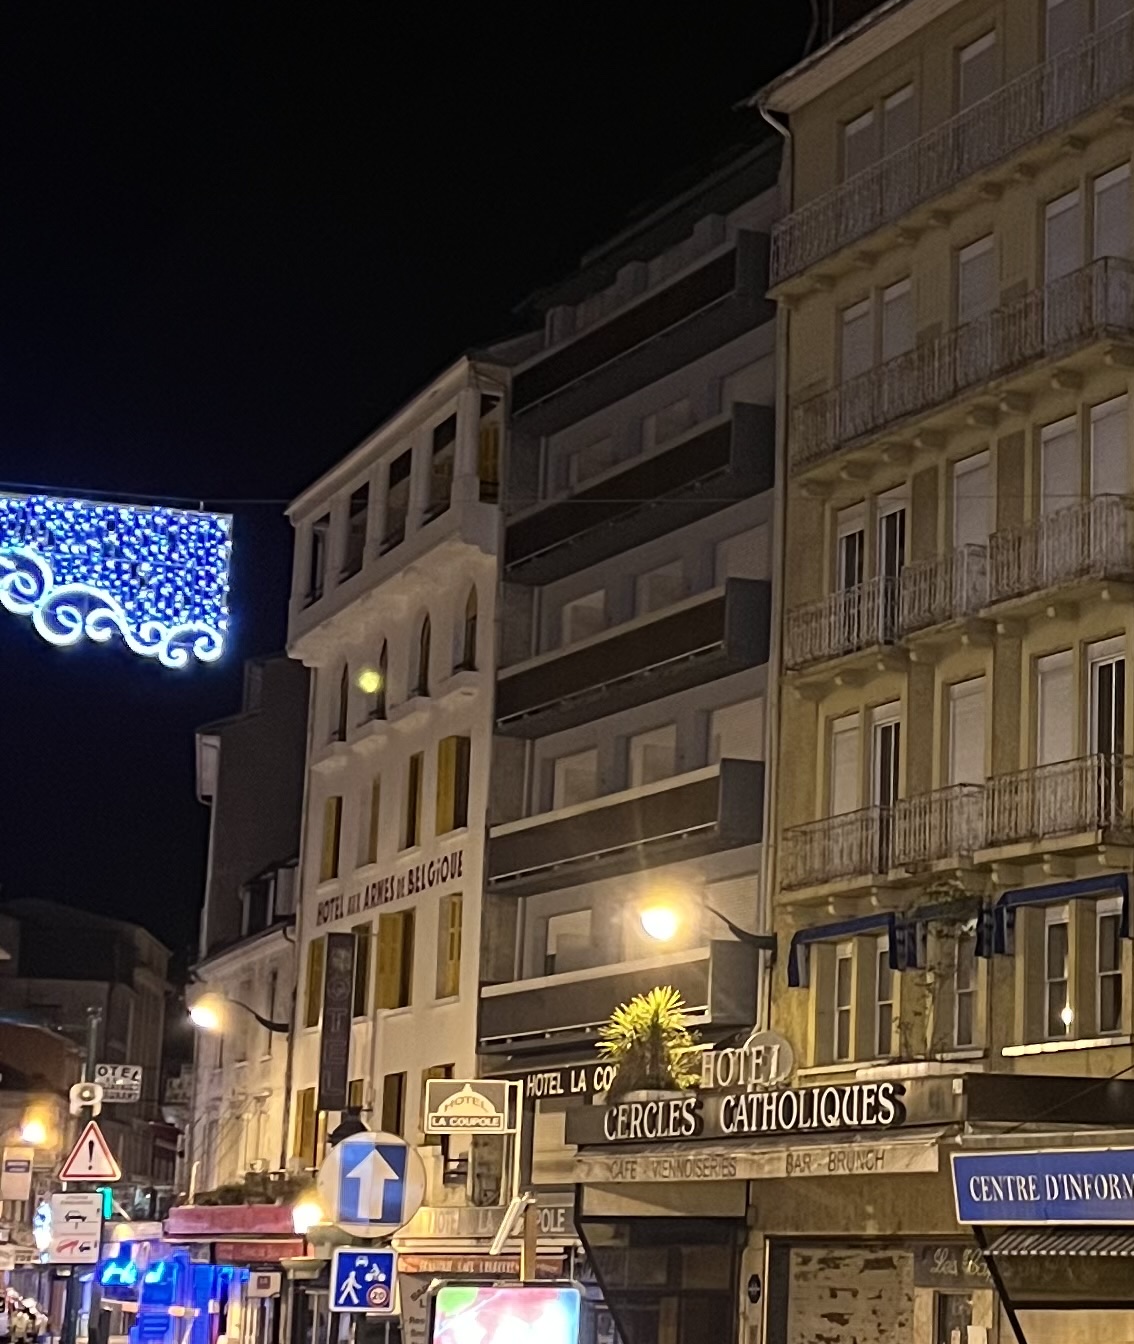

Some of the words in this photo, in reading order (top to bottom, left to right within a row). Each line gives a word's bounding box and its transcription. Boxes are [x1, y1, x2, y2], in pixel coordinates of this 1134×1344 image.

[316, 895, 344, 927] HOTEL
[362, 874, 396, 912] ARMES
[97, 1065, 140, 1083] OTEL
[701, 1043, 783, 1089] HOTEL
[526, 1071, 564, 1097] HOTEL
[570, 1069, 587, 1093] LA
[444, 1094, 488, 1113] HOTEL
[604, 1097, 697, 1141] CERCLES
[719, 1082, 896, 1134] CATHOLIQUES
[431, 1116, 446, 1127] LA
[449, 1116, 500, 1128] COUPOLE
[653, 1156, 738, 1180] VIENNOISERIES
[785, 1151, 812, 1175] BAR
[827, 1148, 886, 1174] BRUNCH
[969, 1173, 1041, 1203] CENTRE
[372, 1291, 385, 1301] 20
